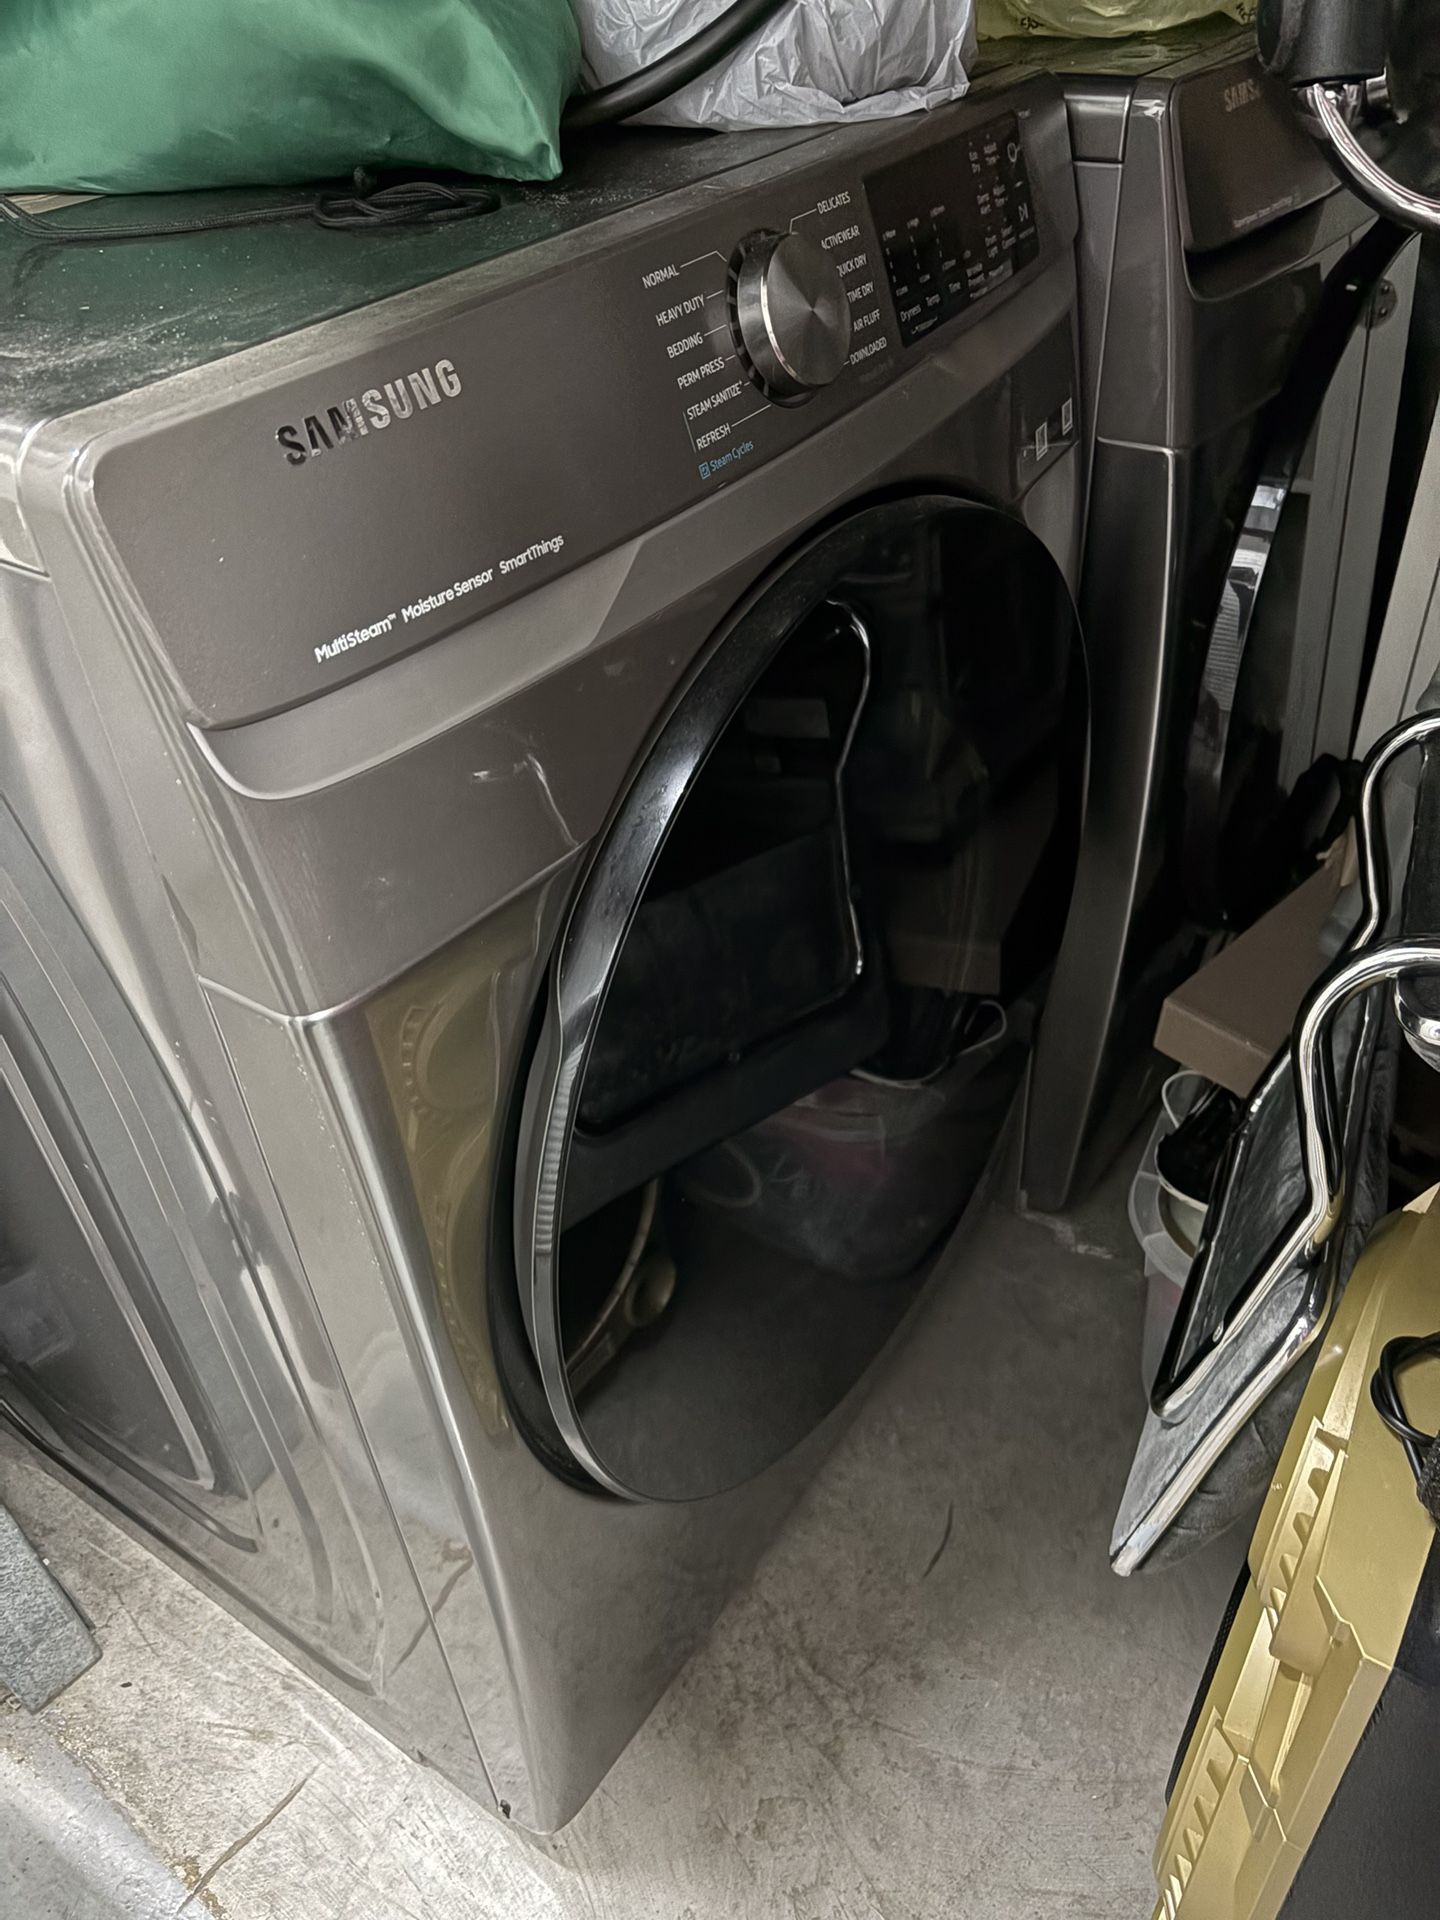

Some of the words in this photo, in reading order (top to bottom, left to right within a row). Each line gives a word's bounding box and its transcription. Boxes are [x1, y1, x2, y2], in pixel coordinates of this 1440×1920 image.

[1224, 79, 1260, 112] SAMS
[817, 191, 851, 215] DELICATES
[854, 253, 867, 269] DRY
[642, 264, 680, 289] NORMAL
[846, 287, 862, 304] TIME
[861, 281, 875, 297] DRY
[655, 305, 684, 327] HEAVY
[683, 294, 705, 314] DUTY
[853, 318, 864, 333] AIR
[863, 308, 880, 327] FLUFF
[900, 303, 922, 322] Dryness
[666, 332, 704, 359] BEDDING
[849, 336, 888, 366] DOWNLOADED
[677, 368, 701, 390] PERM
[699, 356, 726, 379] PRESS
[275, 358, 462, 466] SAMSUNG
[686, 397, 713, 421] STEAM
[695, 422, 732, 451] REFRESH
[709, 452, 733, 472] Steam
[731, 441, 754, 460] Cycles
[401, 588, 455, 623] Moisture
[453, 568, 494, 597] Sensor
[499, 534, 565, 574] SmartThings
